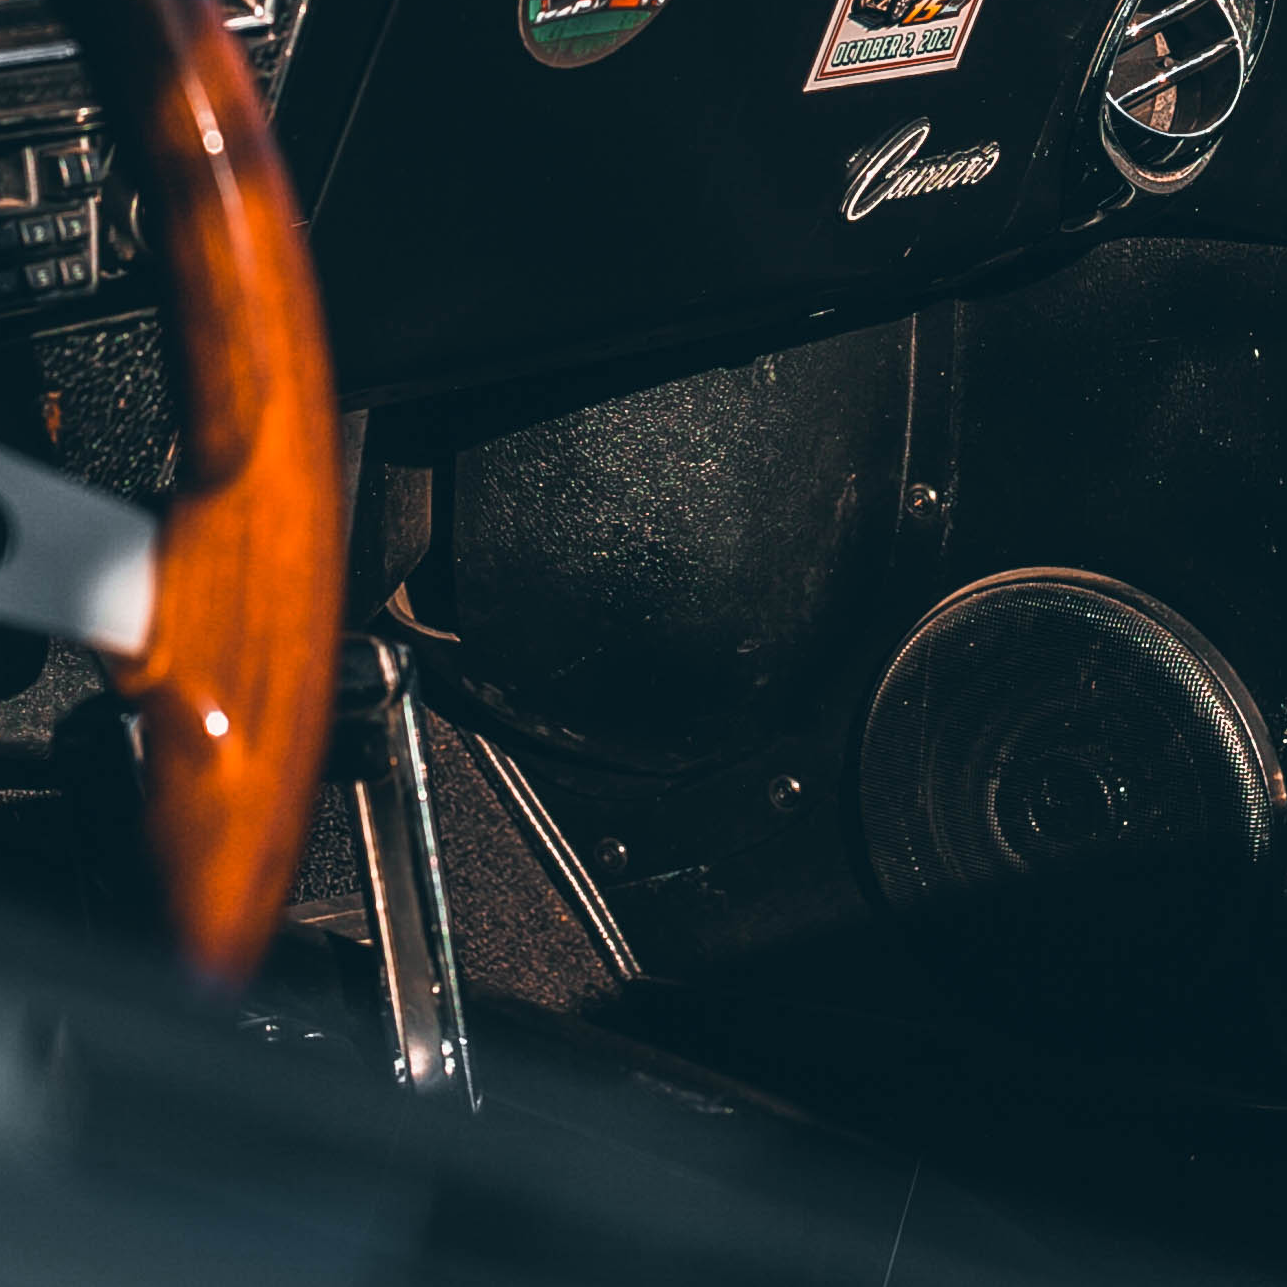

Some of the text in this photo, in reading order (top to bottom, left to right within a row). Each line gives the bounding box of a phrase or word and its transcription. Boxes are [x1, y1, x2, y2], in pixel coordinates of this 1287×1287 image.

[831, 26, 957, 66] OCTOBER 2, 2021
[842, 117, 1001, 222] Camaro
